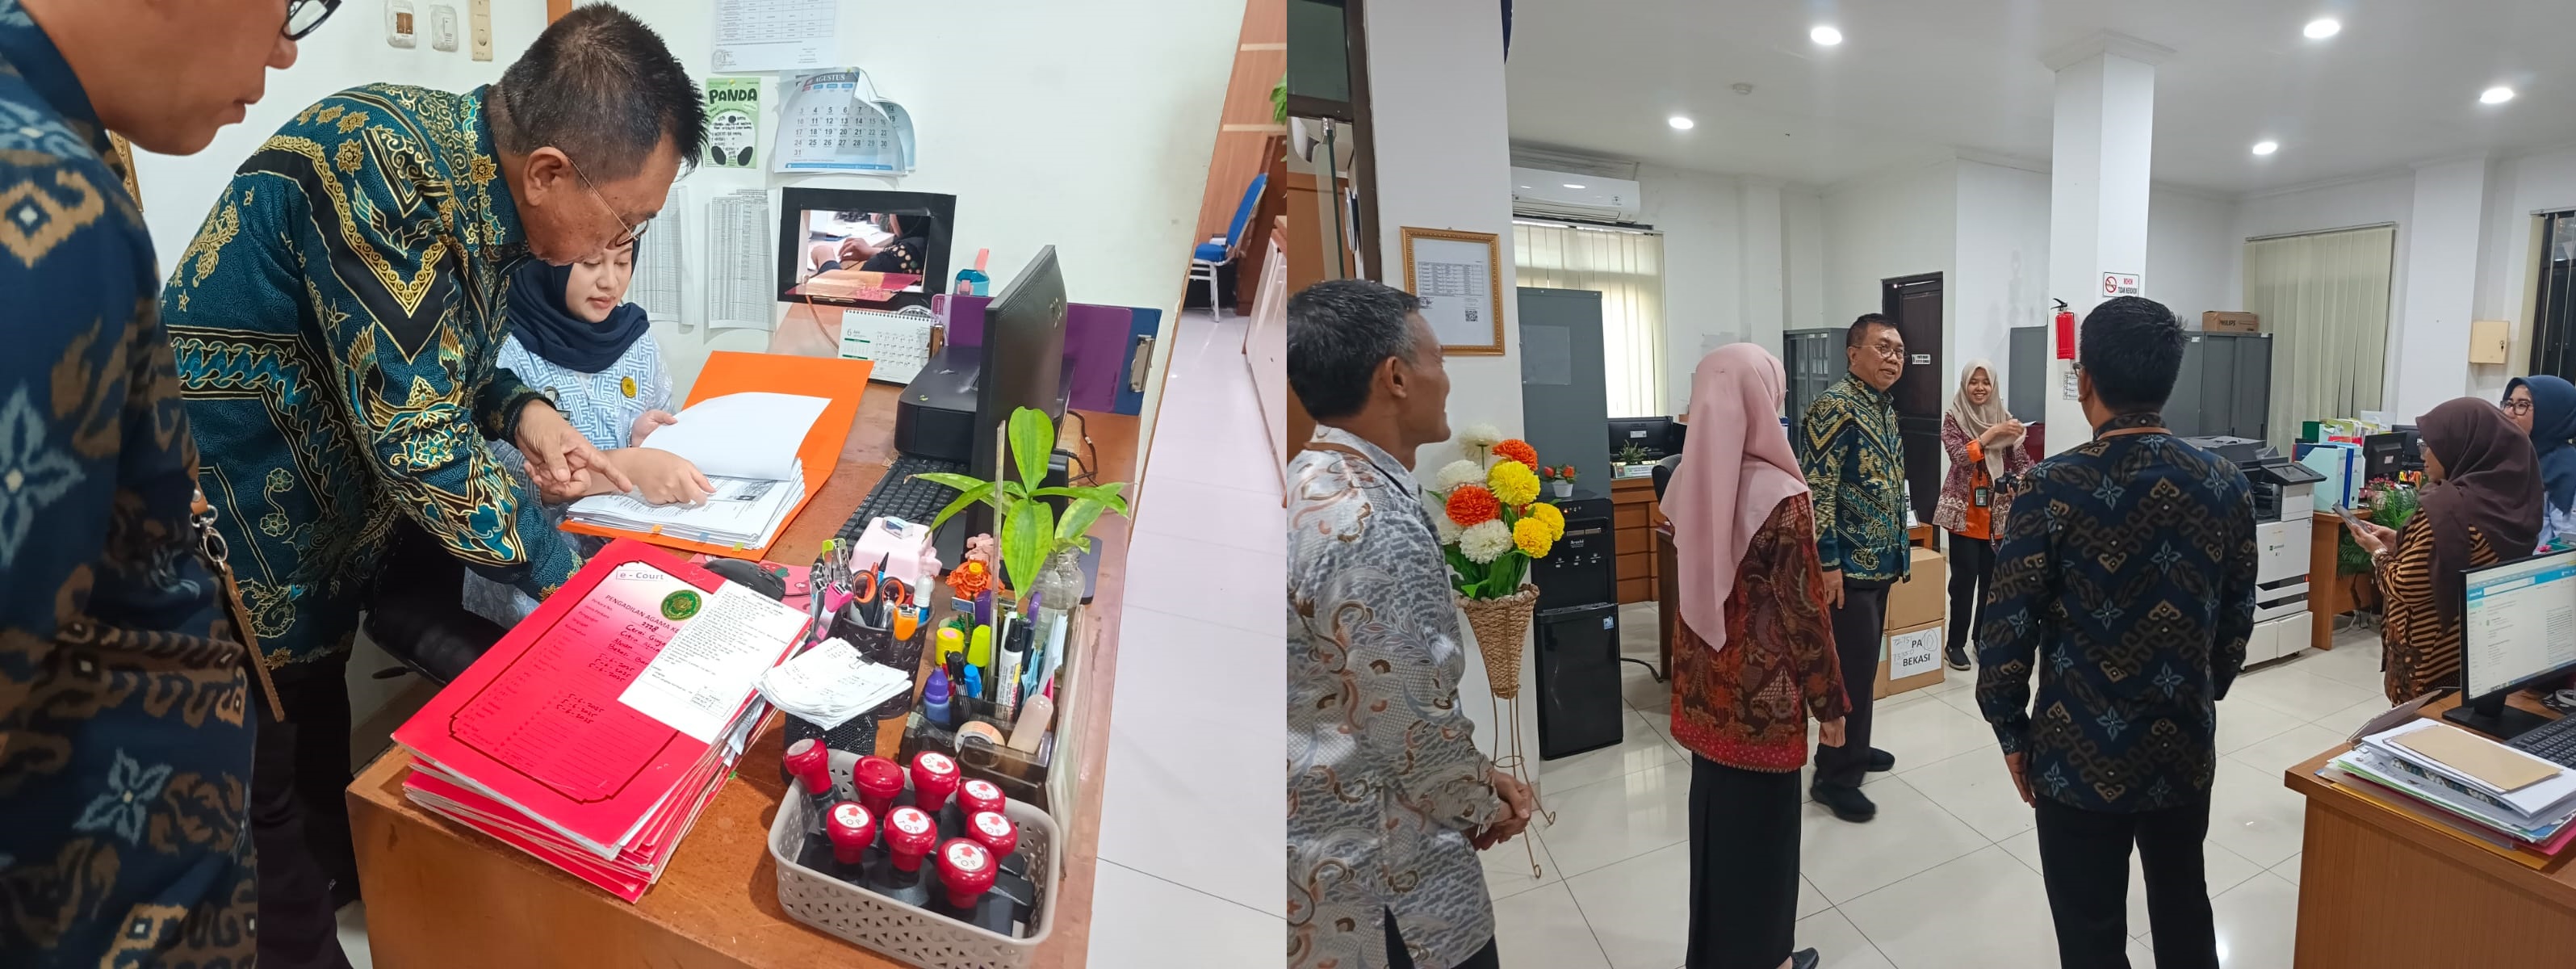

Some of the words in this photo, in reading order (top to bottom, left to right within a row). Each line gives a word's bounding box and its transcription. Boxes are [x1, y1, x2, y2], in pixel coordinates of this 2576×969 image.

[709, 88, 758, 104] PANDA
[635, 572, 664, 581] Court
[605, 594, 646, 618] PENGADILAN
[646, 615, 671, 630] AGAMA
[1912, 640, 1922, 648] PA
[1903, 653, 1930, 667] BEKASI
[840, 814, 861, 826] TOP
[898, 820, 919, 833] TOP
[980, 822, 1001, 835] TOP
[954, 855, 977, 867] TOP
